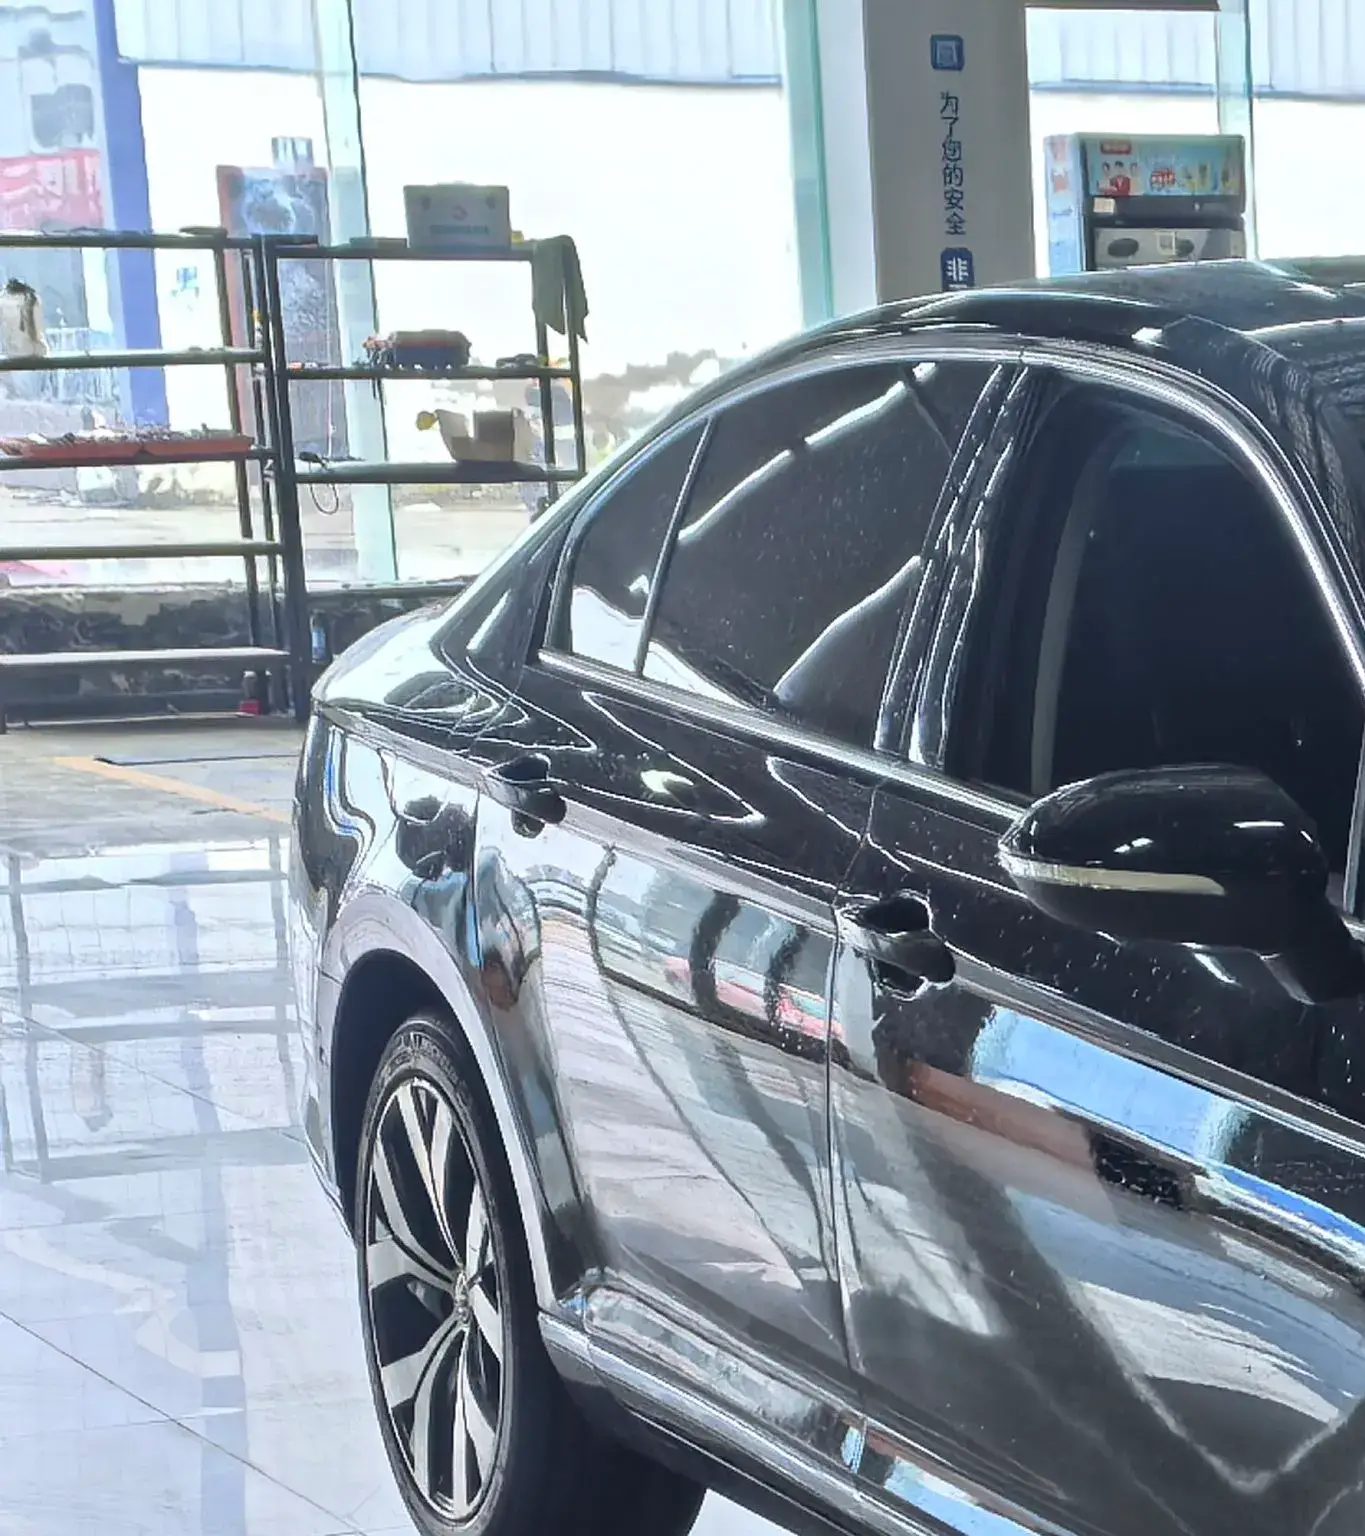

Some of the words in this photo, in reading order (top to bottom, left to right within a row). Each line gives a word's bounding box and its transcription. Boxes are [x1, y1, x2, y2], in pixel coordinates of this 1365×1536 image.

[940, 91, 966, 236] 为了您的安全
